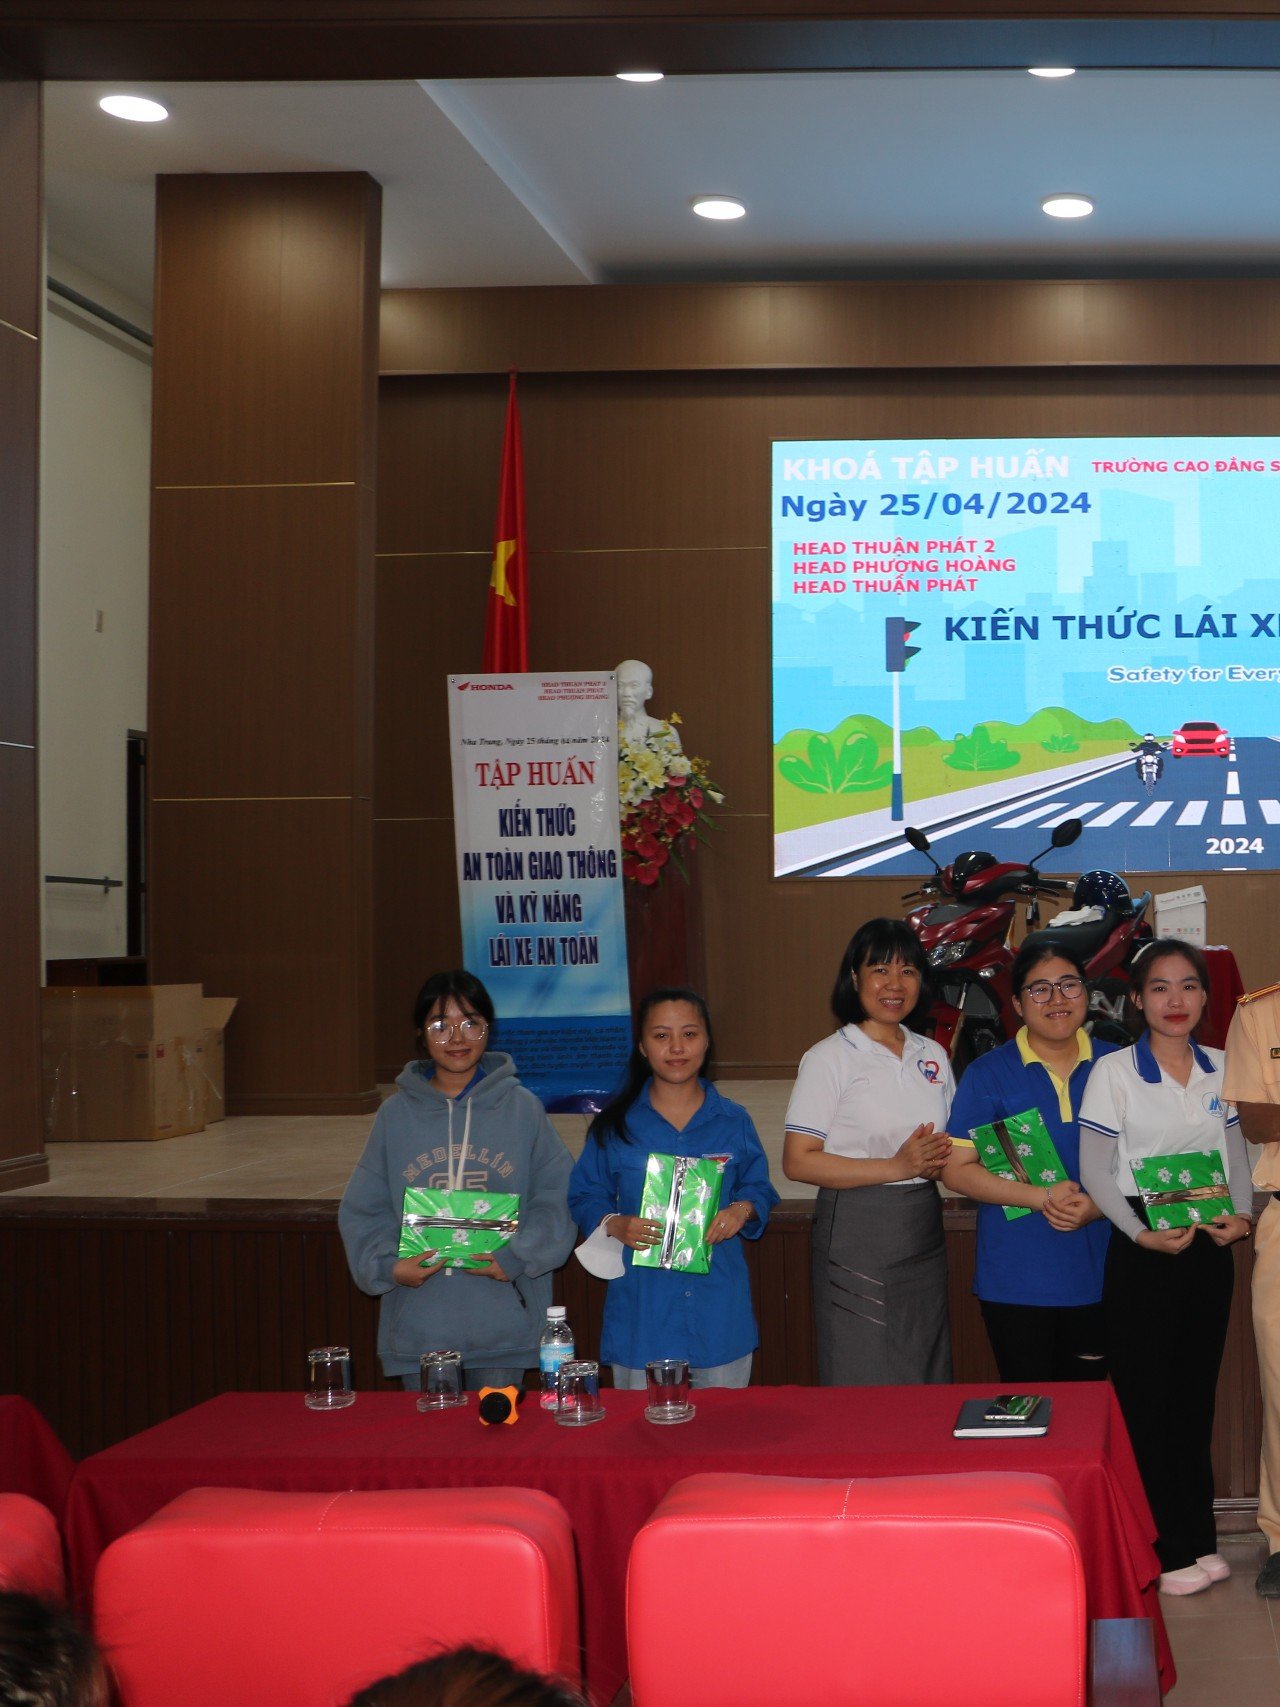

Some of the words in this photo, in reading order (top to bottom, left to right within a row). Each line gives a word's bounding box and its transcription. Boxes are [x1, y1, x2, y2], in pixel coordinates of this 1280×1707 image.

[783, 450, 882, 481] KHOÁ
[891, 449, 959, 484] TẬP
[970, 448, 1070, 479] HUẤN
[1092, 457, 1168, 473] TRƯỜNG
[1173, 460, 1210, 473] CAO
[1214, 456, 1265, 473] ĐẲNG
[781, 491, 868, 523] Ngày
[880, 492, 1092, 520] 25/04/2024
[793, 541, 847, 556] HEAD
[852, 536, 920, 557] THUẬN
[926, 536, 978, 554] PHÁT
[984, 539, 996, 553] 2
[793, 560, 847, 575] HEAD
[945, 555, 1016, 573] HOÀNG
[793, 580, 847, 594] HEAD
[926, 575, 978, 593] PHÁT
[945, 607, 1039, 641] KIẾN
[1052, 605, 1160, 640] THỨC
[1174, 604, 1238, 638] LÁI
[1108, 666, 1185, 683] Safety
[1190, 666, 1222, 681] for
[461, 737, 476, 746] Nha
[526, 737, 536, 745] 25
[475, 758, 522, 790] TẬP
[527, 755, 595, 786] HUẤN
[498, 798, 531, 838] KIẾN
[536, 803, 576, 837] THỨC
[1205, 837, 1265, 855] 2024
[463, 852, 482, 881] AN
[485, 847, 524, 881] TOÀN
[529, 850, 563, 880] GIAO
[567, 845, 617, 879] THÔNG
[495, 890, 516, 923] VÀ
[543, 889, 582, 922] NĂNG
[489, 933, 511, 966] LÁI
[515, 937, 533, 965] XE
[538, 937, 555, 965] AN
[560, 931, 599, 965] TOÀN
